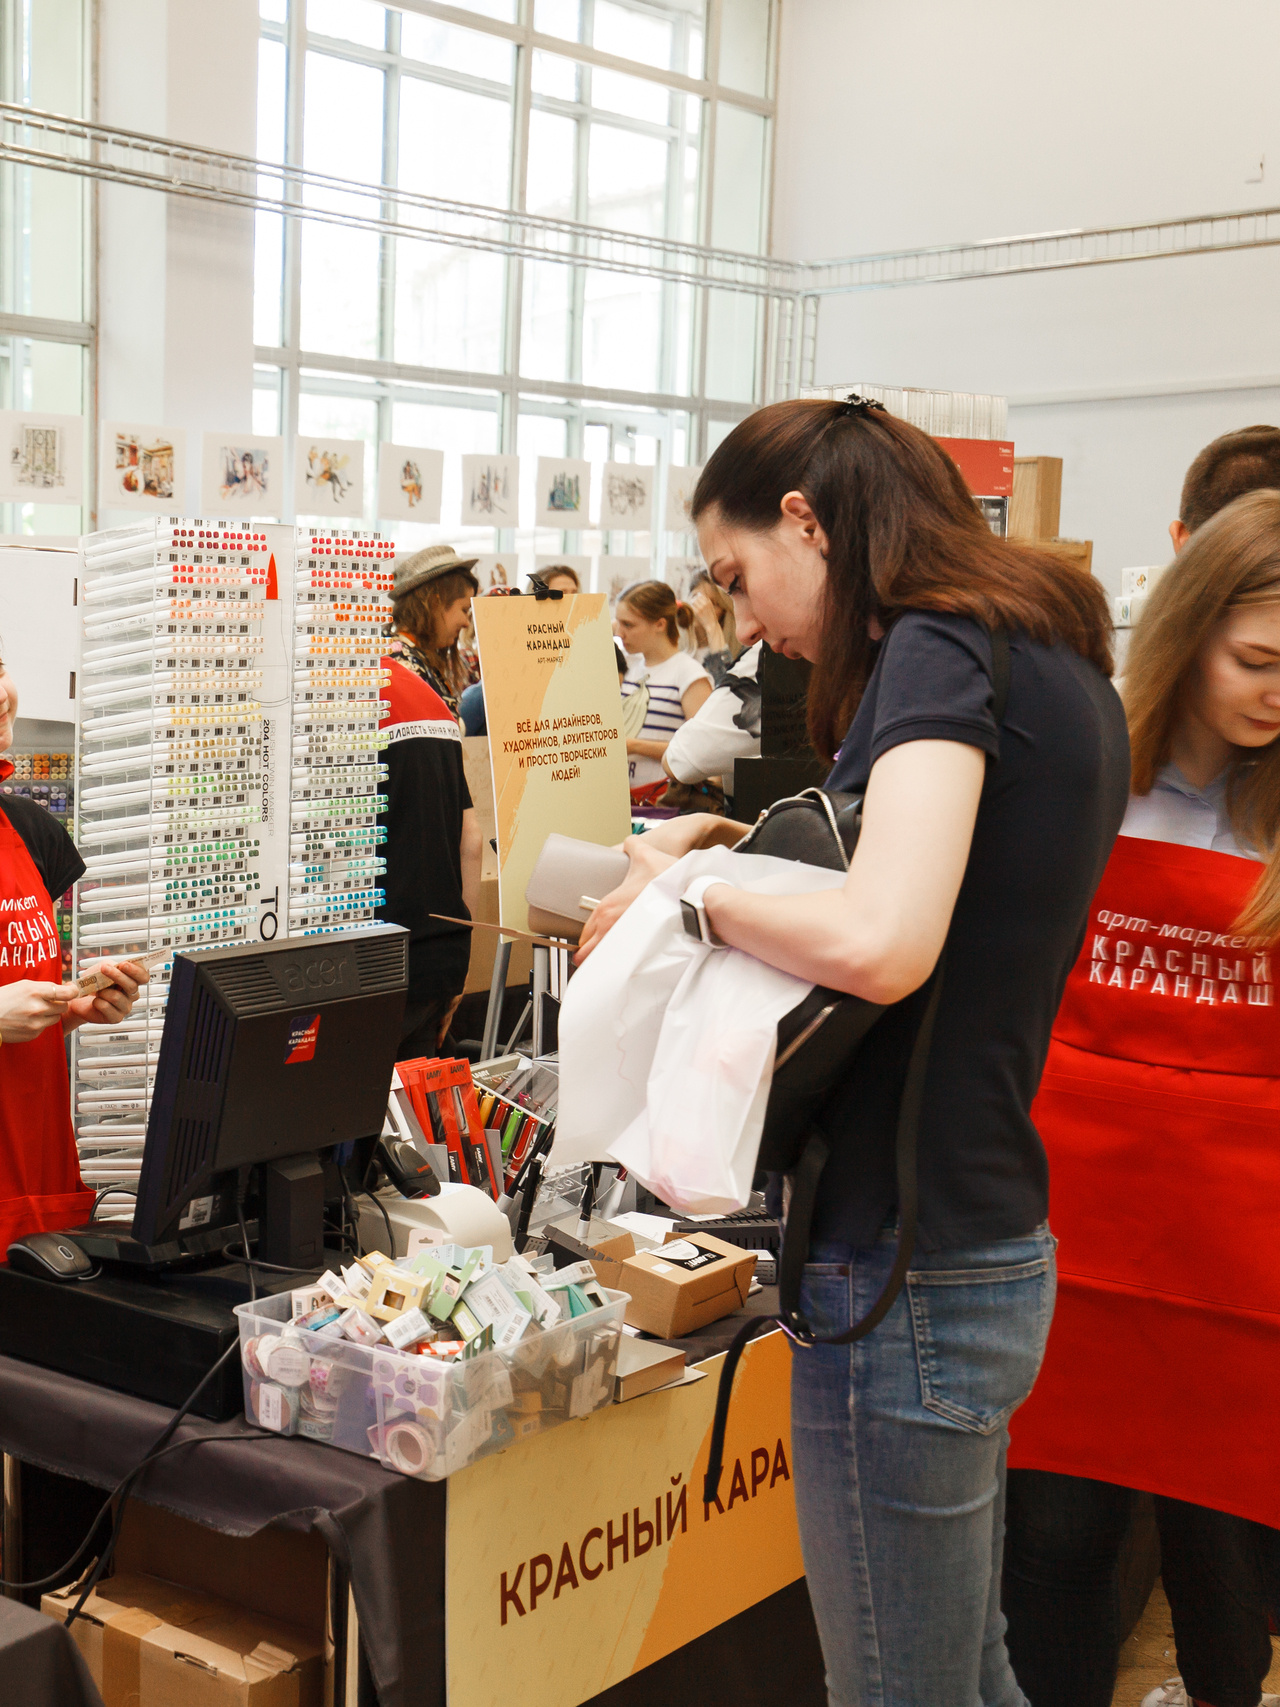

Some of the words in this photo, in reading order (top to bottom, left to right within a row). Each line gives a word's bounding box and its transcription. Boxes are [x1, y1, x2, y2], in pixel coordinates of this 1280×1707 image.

[526, 620, 565, 635] КРАСНЫЙ
[526, 636, 570, 651] КАРАНДАШ
[537, 655, 564, 665] АРТ-МАРКЕТ
[262, 718, 270, 741] 204
[516, 718, 532, 734] ВСЁ
[533, 719, 551, 733] ДЛЯ
[552, 712, 603, 731] ДИЗАЙНЕРОВ,
[268, 718, 276, 756] BRUSH
[503, 735, 560, 753] ХУДОЖНИКОВ,
[562, 726, 619, 746] АРХИТЕКТОРОВ
[262, 745, 270, 769] HOT
[518, 756, 525, 768] И
[526, 752, 558, 767] ПРОСТО
[559, 746, 608, 765] ТВОРЧЕСКИХ
[551, 766, 581, 782] ЛЮДЕЙ!
[261, 774, 269, 823] COLORS
[1091, 934, 1273, 984] КРАСНЫЙ
[284, 957, 348, 992] acer
[1088, 961, 1273, 1006] КАРАНДАШ
[288, 1036, 317, 1045] КАРАНДАШ
[291, 1028, 316, 1037] КРАСНЫЙ
[426, 1069, 442, 1080] LAMY
[450, 1063, 465, 1074] LAMY
[499, 1471, 688, 1626] КРАСНЫЙ
